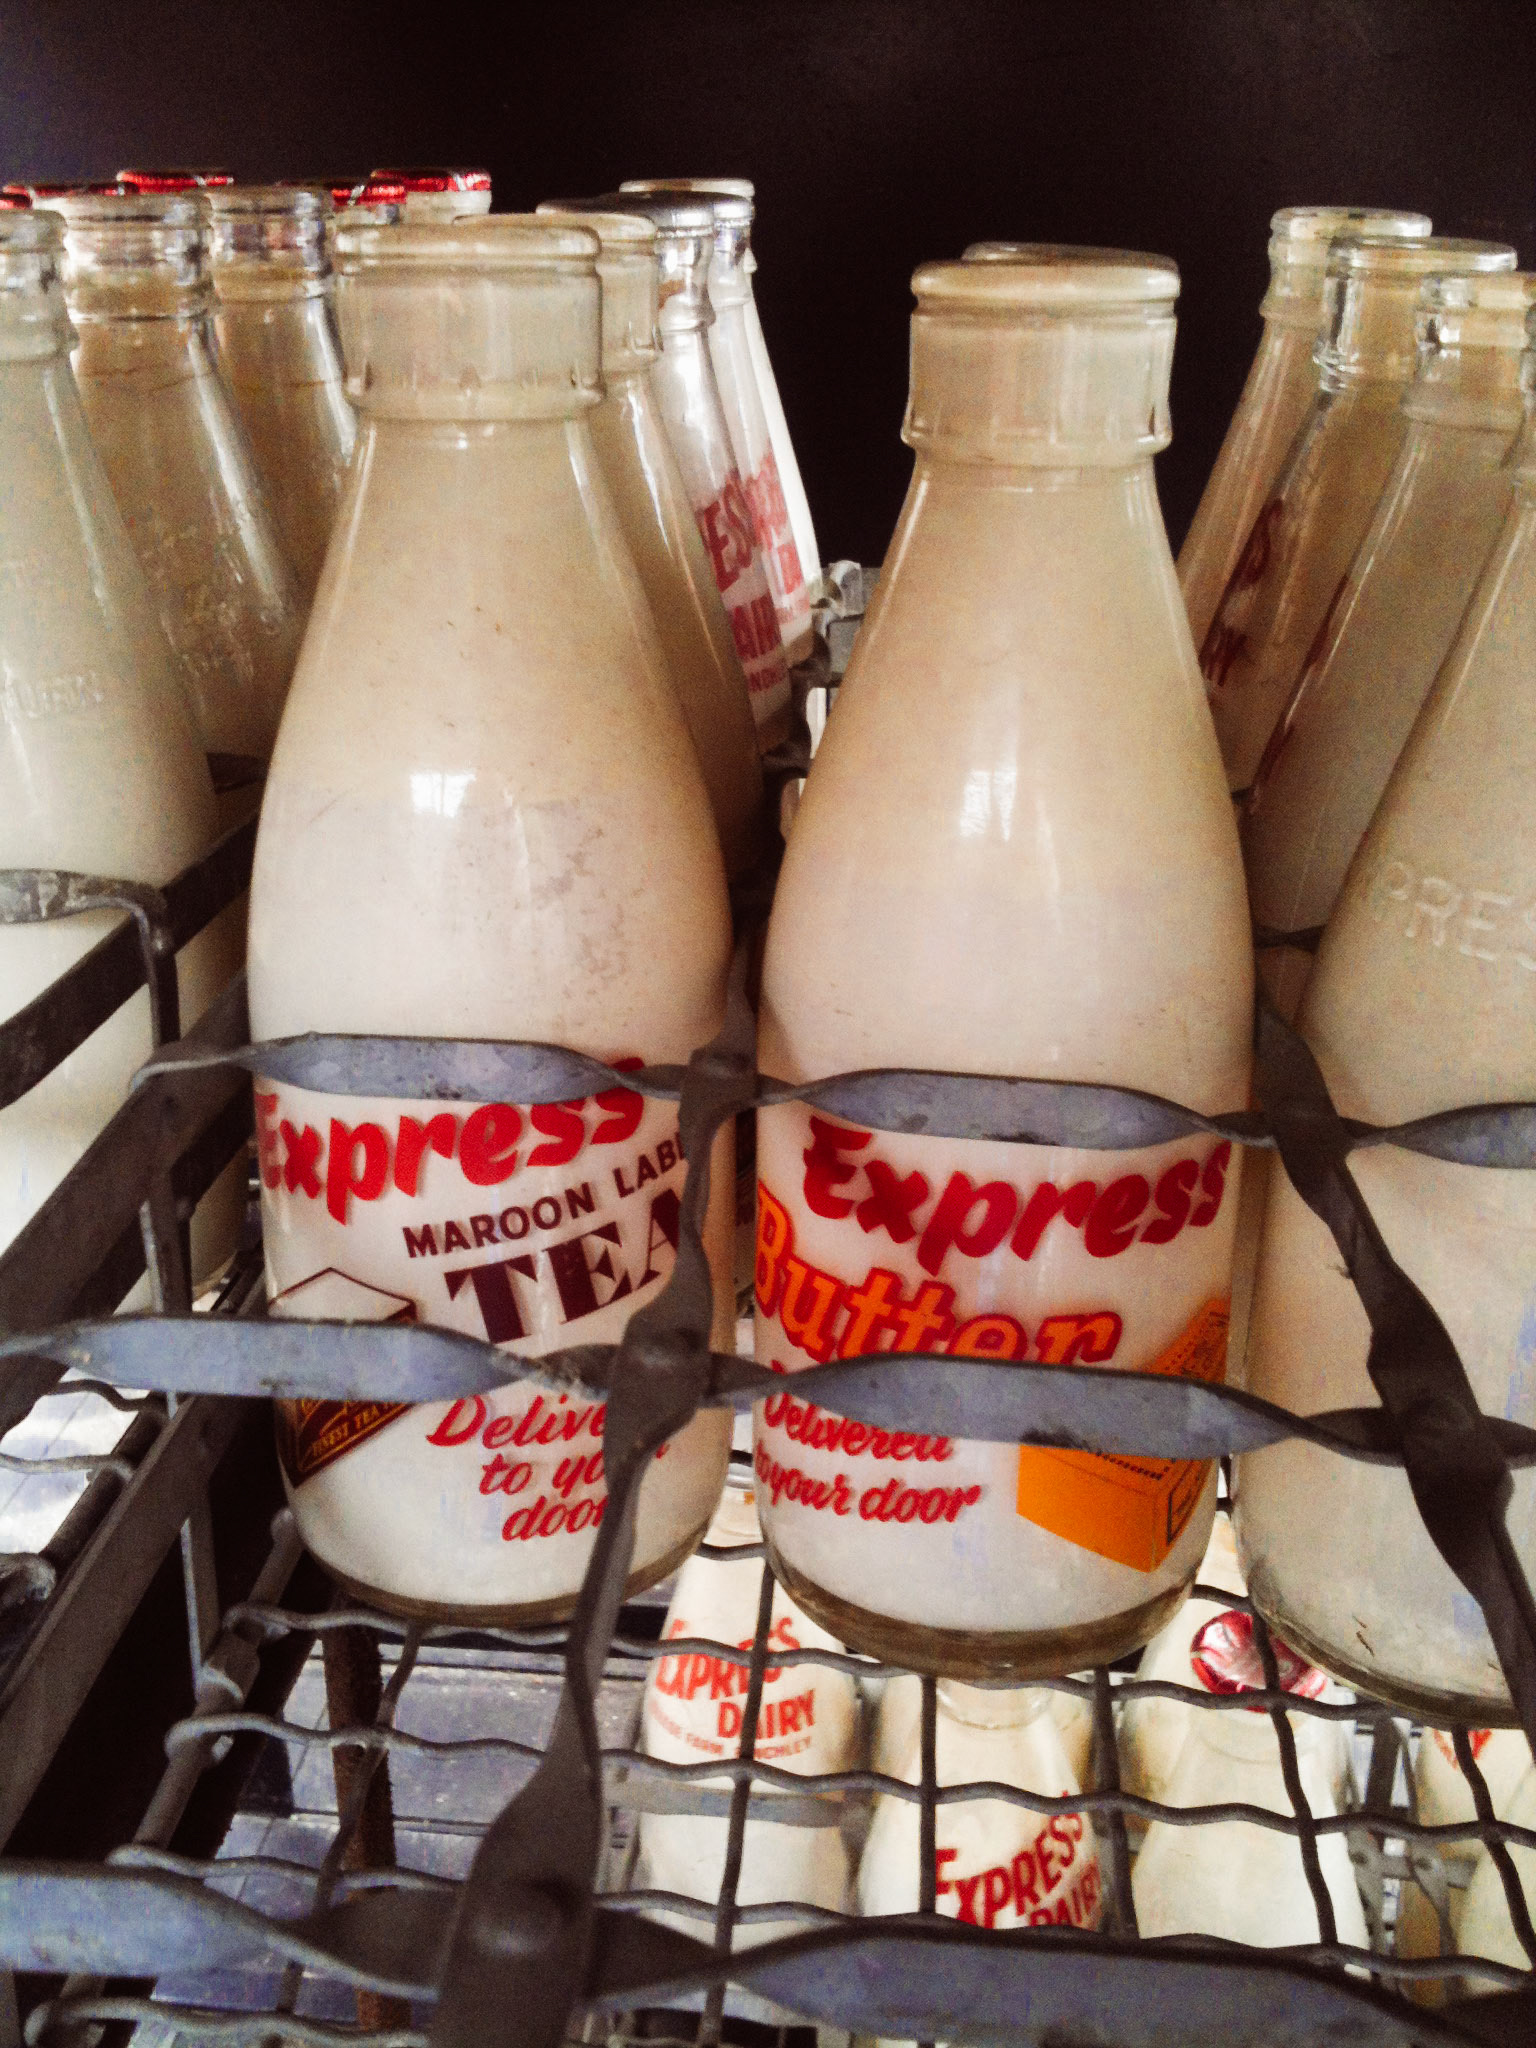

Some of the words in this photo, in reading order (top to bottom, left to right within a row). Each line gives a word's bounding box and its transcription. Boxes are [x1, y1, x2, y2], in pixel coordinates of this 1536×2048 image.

[255, 1057, 645, 1227] Express
[402, 1181, 596, 1258] MAROON
[613, 1131, 685, 1198] LAB
[803, 1115, 1233, 1277] Express
[443, 1188, 681, 1345] TEA
[755, 1178, 1124, 1366] Butter
[426, 1393, 609, 1449] Delive
[479, 1452, 534, 1496] to
[770, 1461, 851, 1516] your
[858, 1478, 983, 1525] door
[717, 1687, 816, 1740] DIRY
